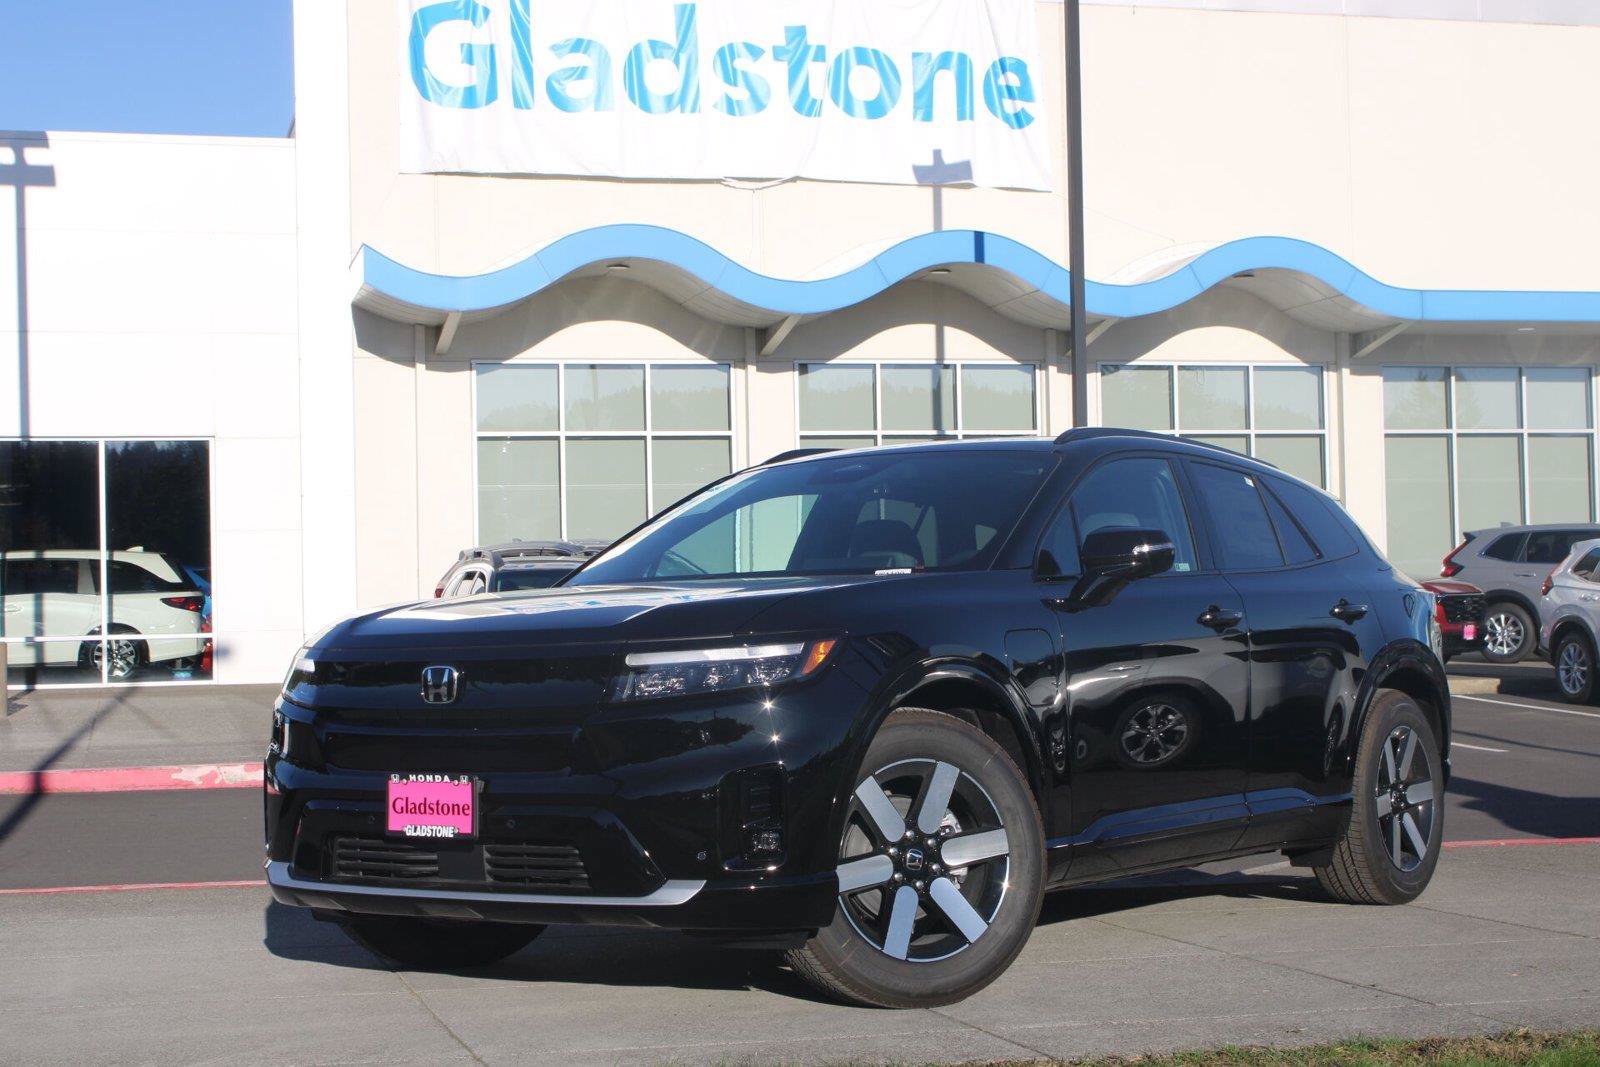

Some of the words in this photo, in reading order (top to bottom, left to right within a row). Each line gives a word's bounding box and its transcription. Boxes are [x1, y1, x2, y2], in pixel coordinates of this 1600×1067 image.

[408, 0, 1037, 129] Gladstone
[409, 774, 451, 783] HONDA
[392, 797, 470, 816] Gladstone
[405, 825, 455, 837] GLADSTONE
